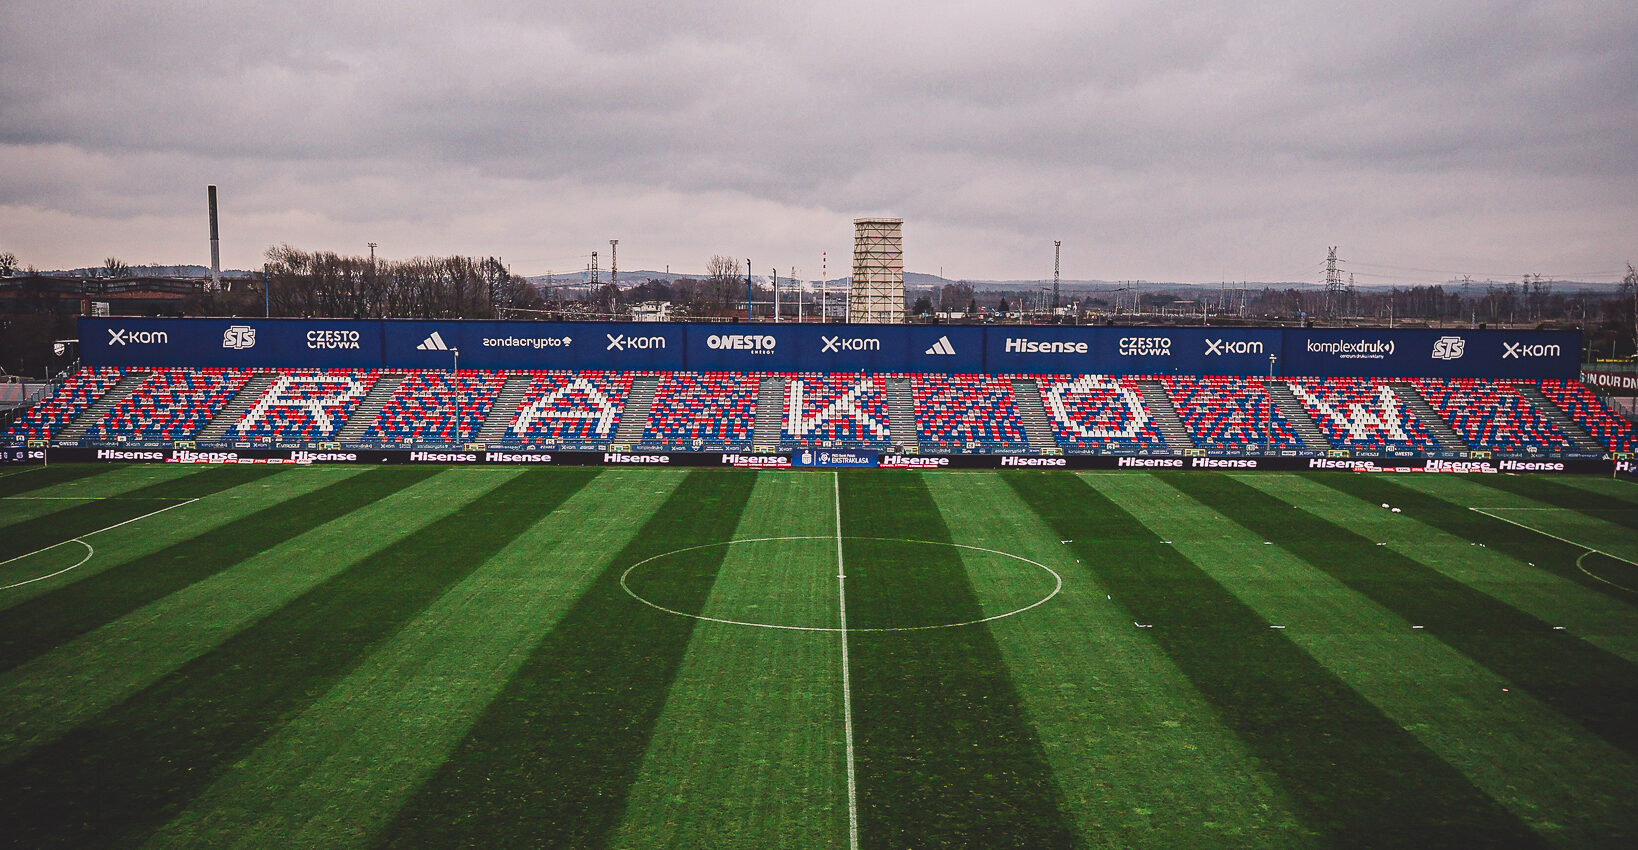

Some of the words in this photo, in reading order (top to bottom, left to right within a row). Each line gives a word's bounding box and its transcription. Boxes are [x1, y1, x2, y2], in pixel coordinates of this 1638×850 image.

[223, 326, 256, 350] STS
[482, 335, 561, 349] zondacrypto
[706, 334, 776, 350] ONESTO
[1005, 337, 1088, 354] Hisense
[1307, 338, 1384, 355] komplexdruk
[1431, 336, 1466, 361] STS
[1599, 374, 1620, 388] OUR
[97, 449, 163, 460] Hisense
[172, 450, 238, 460] Hisense
[290, 451, 357, 461] Hisense
[410, 451, 476, 462] Hisense
[485, 452, 551, 462] Hisense
[604, 453, 669, 463] Hisense
[722, 454, 788, 464] Hisense
[884, 455, 949, 466] Hisense
[1001, 456, 1066, 466] Hisense
[1118, 457, 1183, 467] Hisense
[1191, 457, 1257, 468] Hisense
[1309, 458, 1374, 469] Hisense
[1426, 459, 1490, 470] Hisense
[1499, 460, 1564, 471] Hisense
